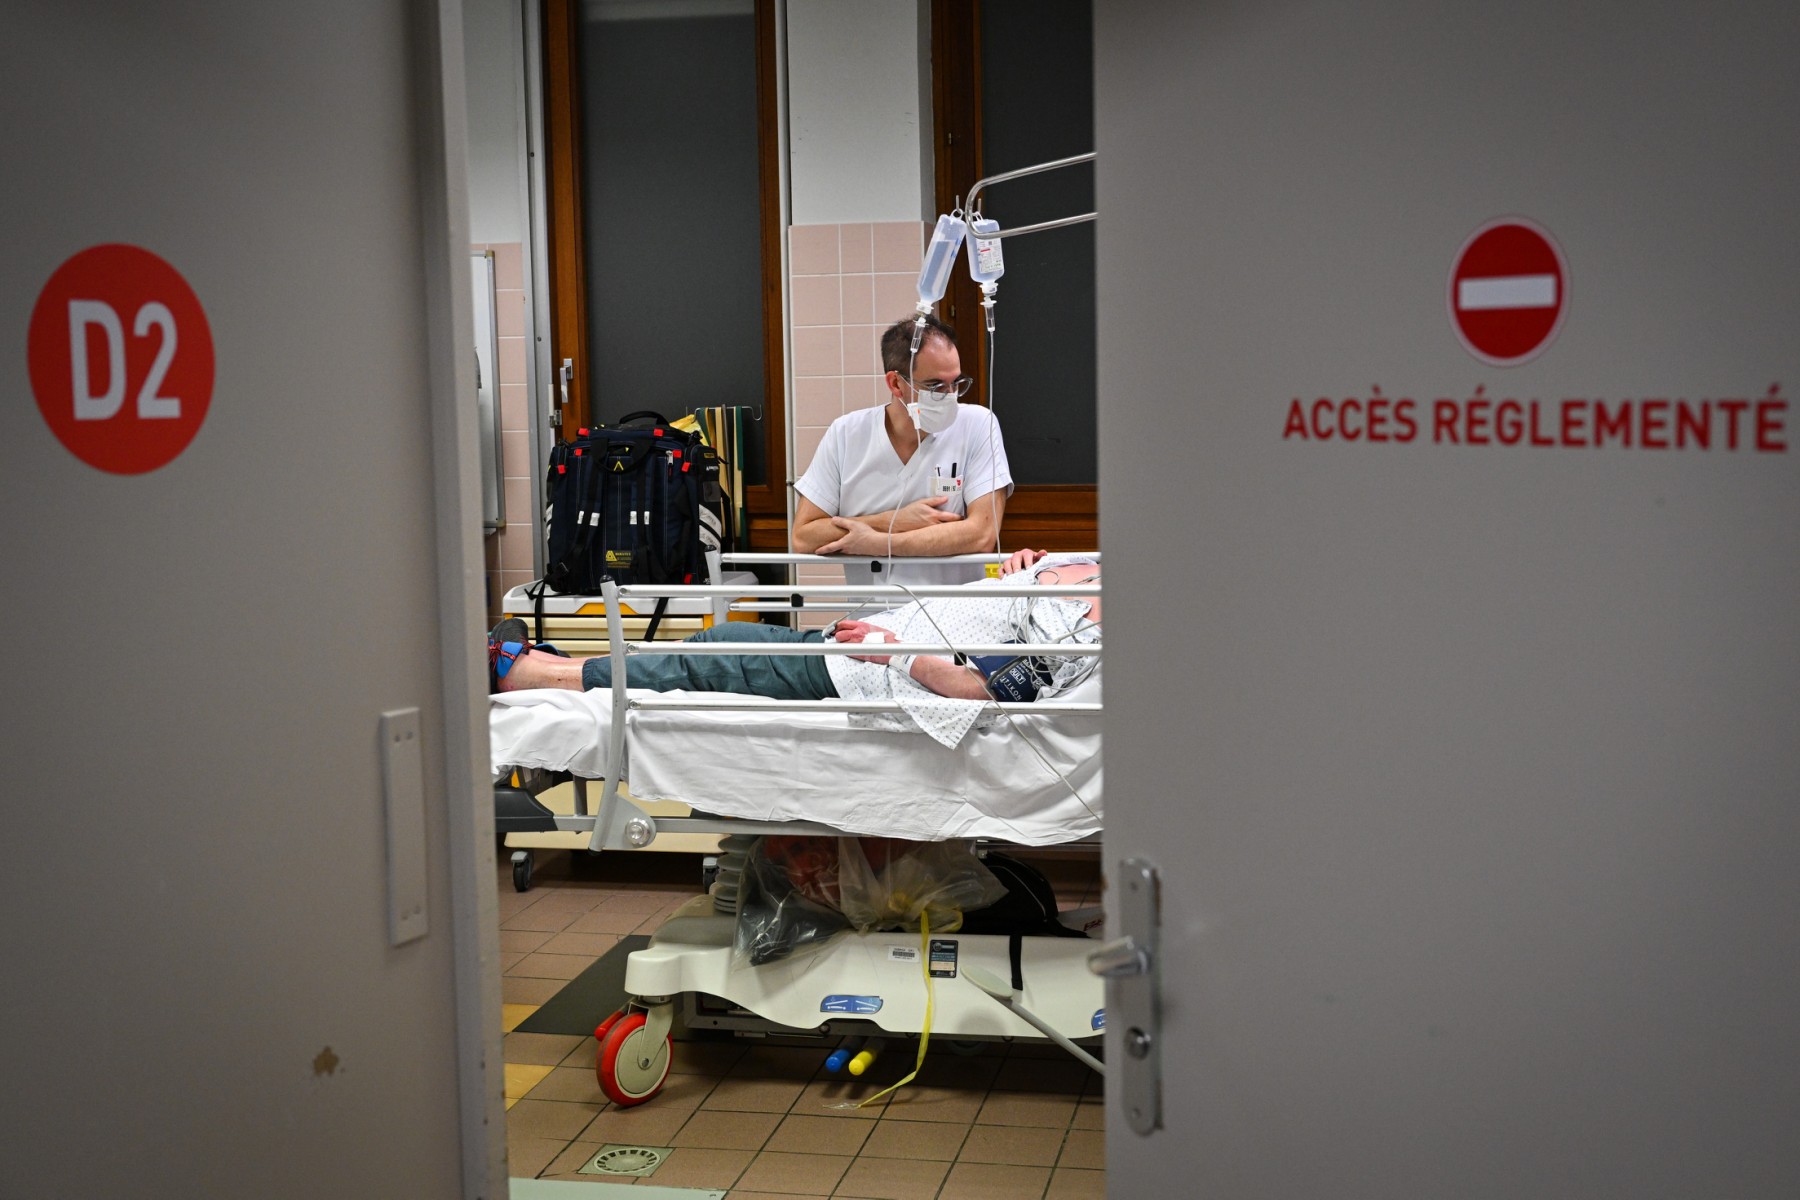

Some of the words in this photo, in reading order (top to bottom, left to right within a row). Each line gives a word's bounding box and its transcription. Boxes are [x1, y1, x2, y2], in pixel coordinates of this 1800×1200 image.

[68, 299, 181, 420] D2
[1282, 384, 1418, 443] ACCÈS
[1433, 383, 1789, 453] RÉGLEMENTÉ
